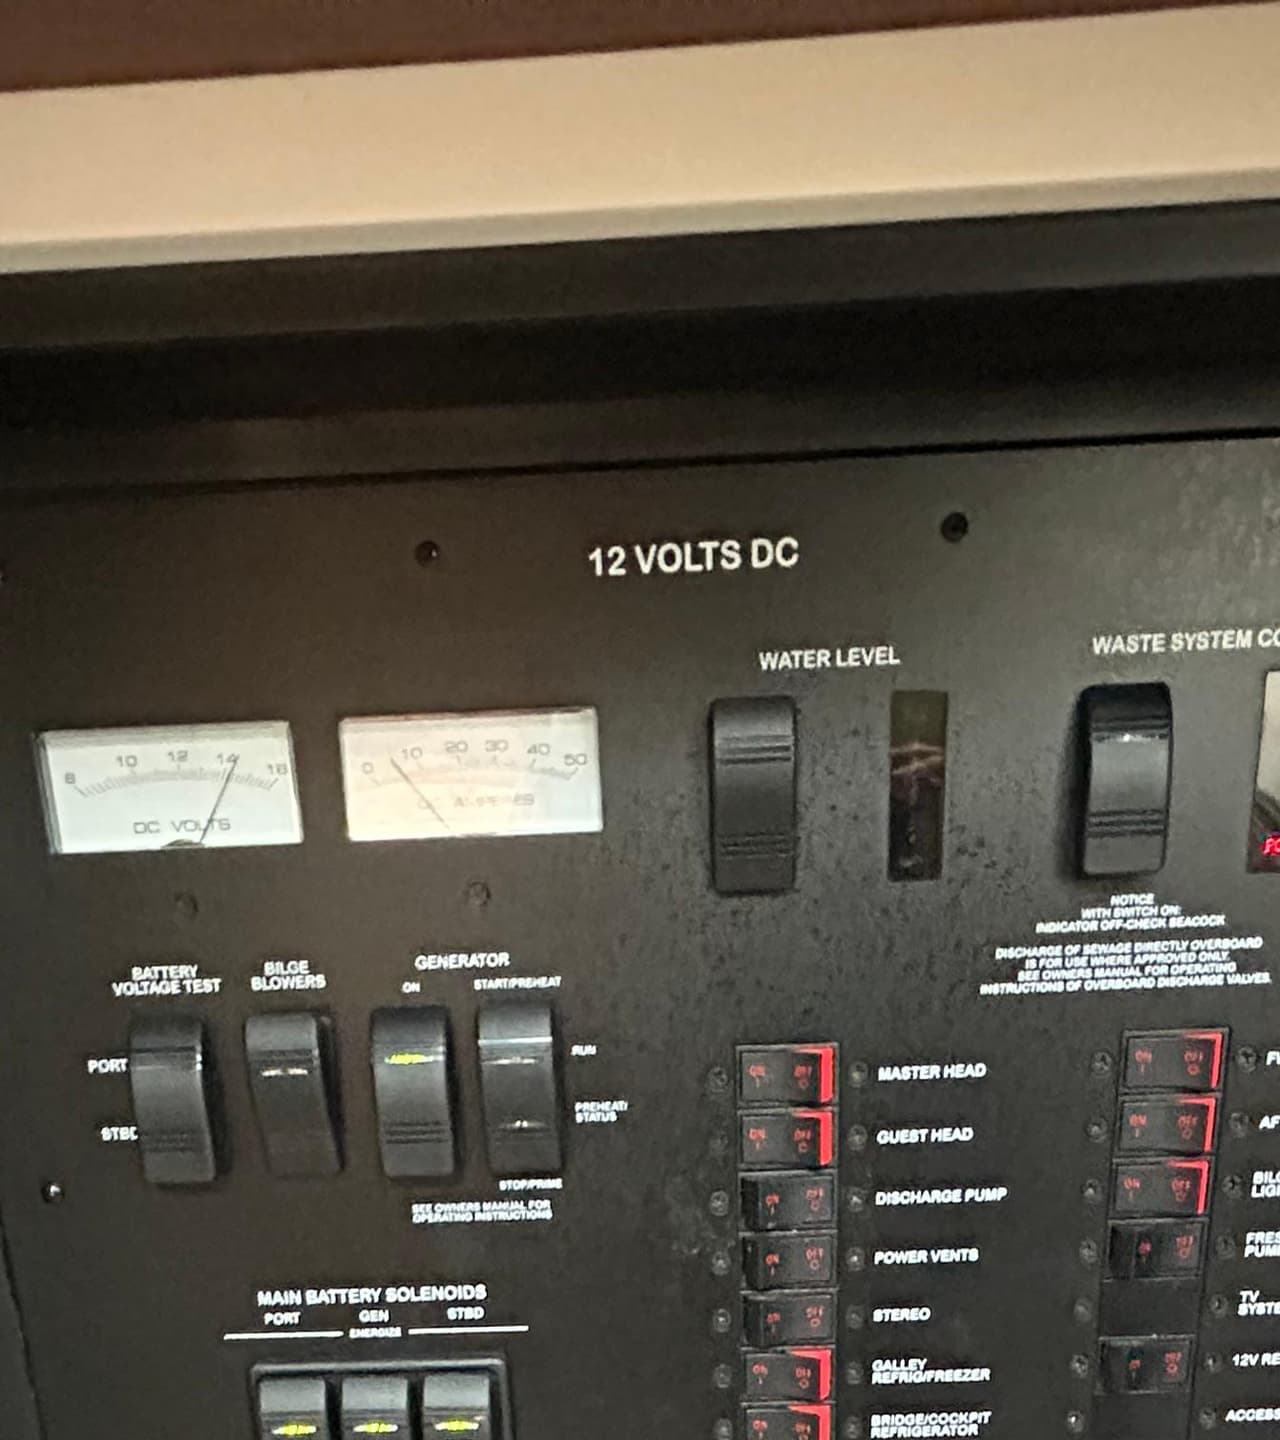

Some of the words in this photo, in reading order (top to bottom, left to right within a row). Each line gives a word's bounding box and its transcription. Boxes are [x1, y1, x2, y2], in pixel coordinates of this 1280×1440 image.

[588, 547, 626, 577] 12
[635, 540, 742, 574] VOLTS
[752, 537, 800, 568] DC
[1092, 635, 1166, 654] WASTE
[1170, 629, 1252, 651] SYSTEM
[759, 650, 831, 671] WATER
[836, 646, 900, 667] LEVEL
[117, 755, 138, 767] 10
[167, 751, 188, 763] 12
[402, 747, 423, 760] 10
[445, 740, 469, 754] 20
[485, 739, 509, 753] 30
[526, 743, 551, 756] 40
[564, 753, 588, 767] 50
[133, 821, 160, 835] DC
[171, 818, 231, 833] VOLTS
[1111, 893, 1154, 906] NOTICE
[1081, 907, 1111, 920] WITH
[1113, 907, 1158, 919] SWITCH
[1036, 920, 1098, 934] INDICATOR
[1169, 915, 1226, 928] SEACOCK
[995, 946, 1063, 960] DISCHARGE
[1064, 945, 1081, 956] OF
[1083, 943, 1132, 955] SEWAGE
[1134, 940, 1189, 954] DIRECTLY
[1193, 936, 1263, 951] OVERBOARD
[264, 960, 310, 975] BILGE
[414, 952, 511, 971] GENERATOR
[1026, 959, 1037, 970] IS
[1039, 957, 1063, 969] FOR
[1066, 956, 1090, 968] USE
[1091, 954, 1131, 967] WHERE
[1134, 952, 1196, 966] APPROVED
[131, 965, 198, 980] BATTERY
[1017, 970, 1041, 983] SEE
[1043, 968, 1092, 981] OWNERS
[1094, 966, 1142, 978] MANUAL
[1144, 965, 1168, 977] FOR
[1170, 962, 1237, 975] OPERATING
[113, 980, 181, 997] VOLTAGE
[183, 978, 222, 994] TEST
[251, 974, 326, 991] BLOWERS
[402, 981, 420, 993] ON
[474, 976, 562, 991] START/PREHEAT
[980, 980, 1064, 995] INSTRUCTIONS
[1067, 980, 1082, 992] OF
[1085, 977, 1155, 990] OVERBOARD
[1157, 975, 1225, 988] DISCHARGE
[570, 1045, 597, 1056] RUN
[87, 1058, 128, 1074] PORT
[878, 1065, 941, 1081] MASTER
[944, 1063, 987, 1078] HEAD
[576, 1112, 617, 1123] STATUS
[876, 1129, 929, 1144] GUEST
[930, 1127, 974, 1141] HEAD
[875, 1189, 962, 1205] DISCHARGE
[965, 1187, 1008, 1202] PUMP
[528, 1200, 550, 1210] FOR
[874, 1250, 928, 1264] POWER
[931, 1248, 979, 1262] VENTS
[257, 1290, 302, 1306] MAIN
[306, 1287, 382, 1305] BATTERY
[385, 1284, 487, 1303] SOLENOIDS
[1240, 1290, 1259, 1303] TV
[264, 1311, 301, 1325] PORT
[358, 1309, 390, 1323] GEN
[447, 1306, 485, 1320] STBD
[873, 1308, 931, 1322] STEREO
[872, 1359, 927, 1371] GALLEY
[1232, 1354, 1260, 1367] 12V
[872, 1368, 991, 1384] REFRIG/FREEZER
[871, 1412, 992, 1426] BRIDGE/COCKPIT
[871, 1425, 979, 1438] REFRIGERATOR
